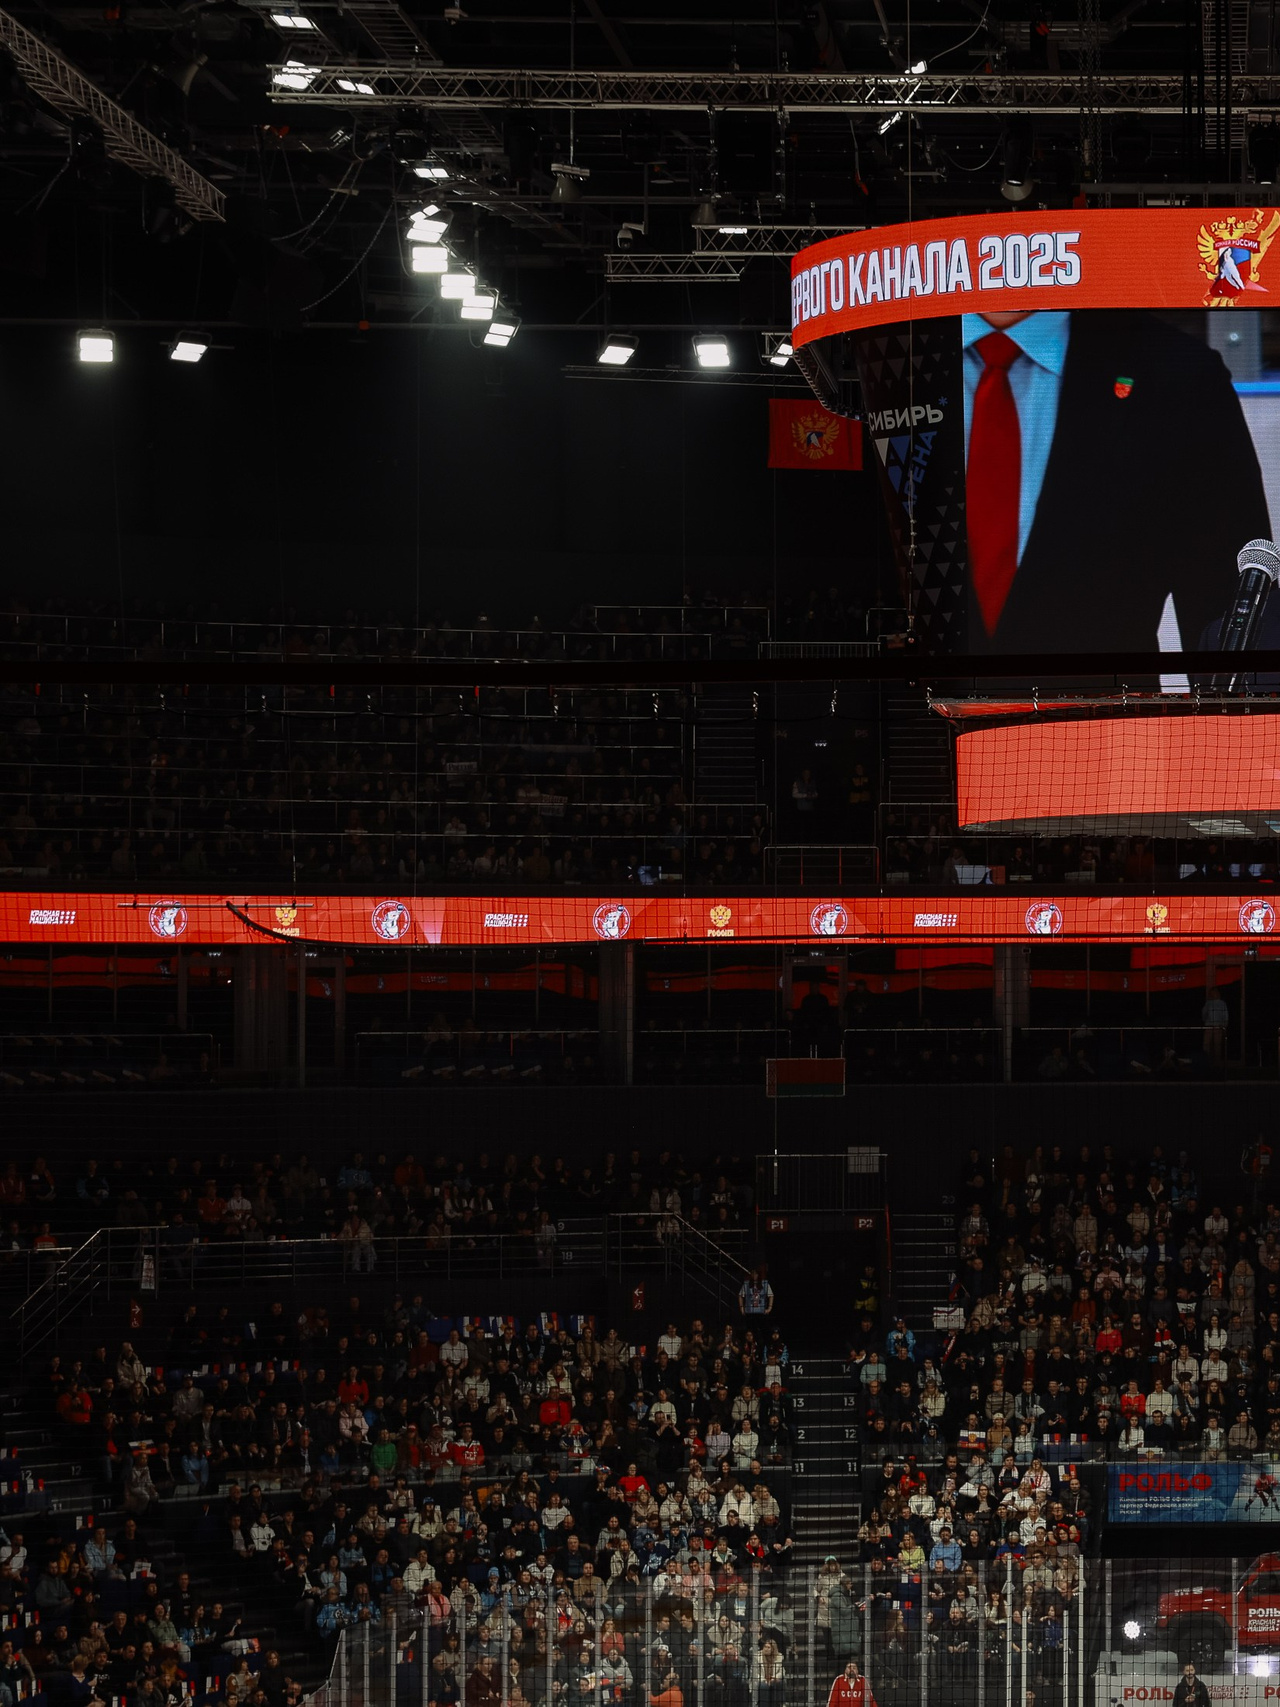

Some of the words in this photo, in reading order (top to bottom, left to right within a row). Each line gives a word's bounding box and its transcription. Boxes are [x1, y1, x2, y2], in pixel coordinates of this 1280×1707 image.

[791, 257, 845, 331] ЕРВОГО
[848, 236, 972, 308] КАНАЛА
[979, 231, 1082, 289] 2025
[868, 403, 943, 432] СИБИРЬ
[901, 430, 938, 517] АРЕНА
[858, 1219, 873, 1228] P2
[792, 1365, 804, 1375] 14
[793, 1398, 805, 1408] 13
[844, 1396, 855, 1406] 13
[845, 1429, 857, 1439] 12
[1119, 1472, 1212, 1492] РОЛЬФ
[1123, 1687, 1174, 1701] РОЛЬ
